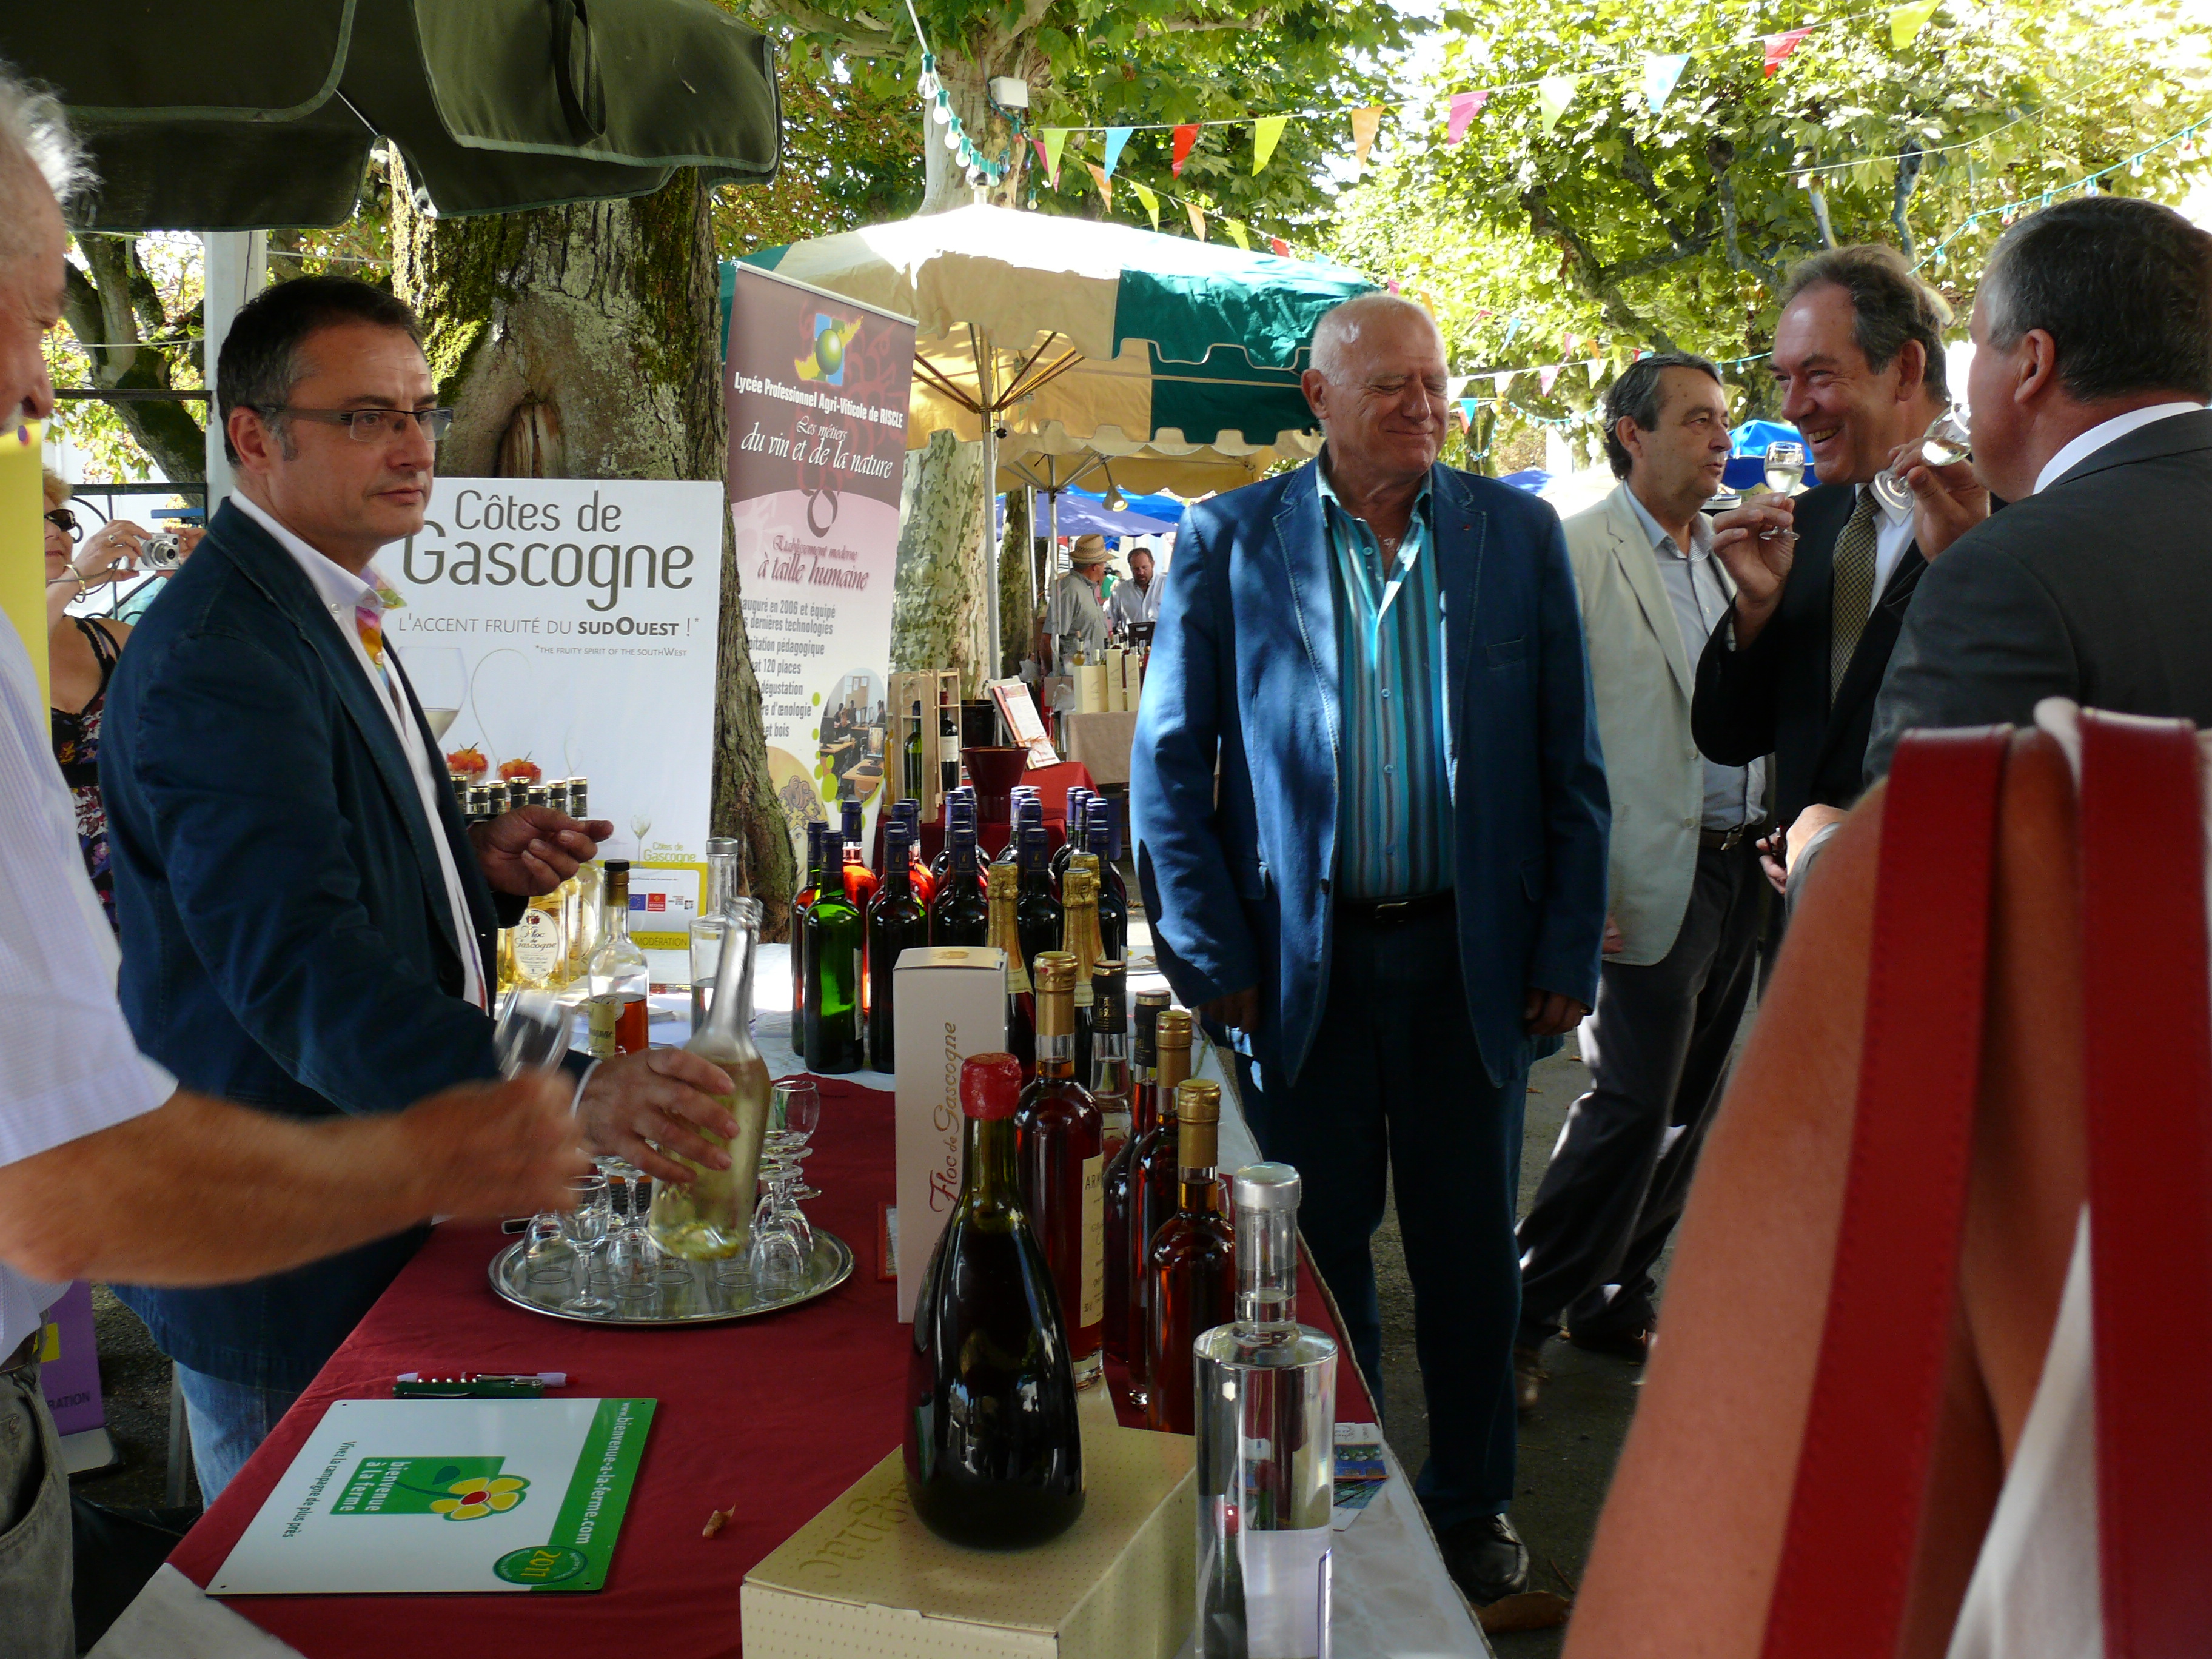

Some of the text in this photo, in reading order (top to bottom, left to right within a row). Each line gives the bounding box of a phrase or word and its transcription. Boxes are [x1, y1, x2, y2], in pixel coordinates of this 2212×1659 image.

[734, 372, 903, 429] Lycée Professionnel Agri-Viticole de RISCLE
[796, 415, 848, 441] Les métiers
[740, 421, 893, 479] du vin et de la nature
[455, 489, 622, 532] Côtes de
[402, 520, 694, 612] Gascogne
[757, 551, 870, 591] à taille humaine
[770, 601, 778, 613] en
[780, 600, 798, 615] 2006
[800, 603, 808, 616] et
[810, 602, 836, 621] équipé
[398, 612, 479, 632] L'ACCENT
[485, 617, 540, 634] FRUITÉ
[547, 620, 571, 634] DU
[751, 612, 783, 631] dernières
[785, 618, 833, 637] technologies
[777, 638, 825, 657] pédagogique
[763, 659, 776, 673] 120
[777, 659, 801, 676] places
[760, 680, 803, 697] dégustation
[774, 722, 789, 737] bois
[675, 842, 683, 851] de
[644, 849, 696, 866] Gascogne
[635, 936, 688, 946] MODÉRATION
[929, 1022, 966, 1213] Floc de Gascogne
[47, 1390, 90, 1410] RATION
[333, 1441, 357, 1457] Vivez
[309, 1465, 337, 1496] campagne
[358, 1470, 383, 1480] la
[575, 1401, 634, 1544] www.bienvenue-a-la-ferme.com
[338, 1482, 375, 1511] ferme
[364, 1461, 412, 1511] bienvenue
[303, 1497, 320, 1506] de
[293, 1507, 313, 1521] plus
[282, 1523, 302, 1538] près
[520, 1550, 561, 1577] 2011
